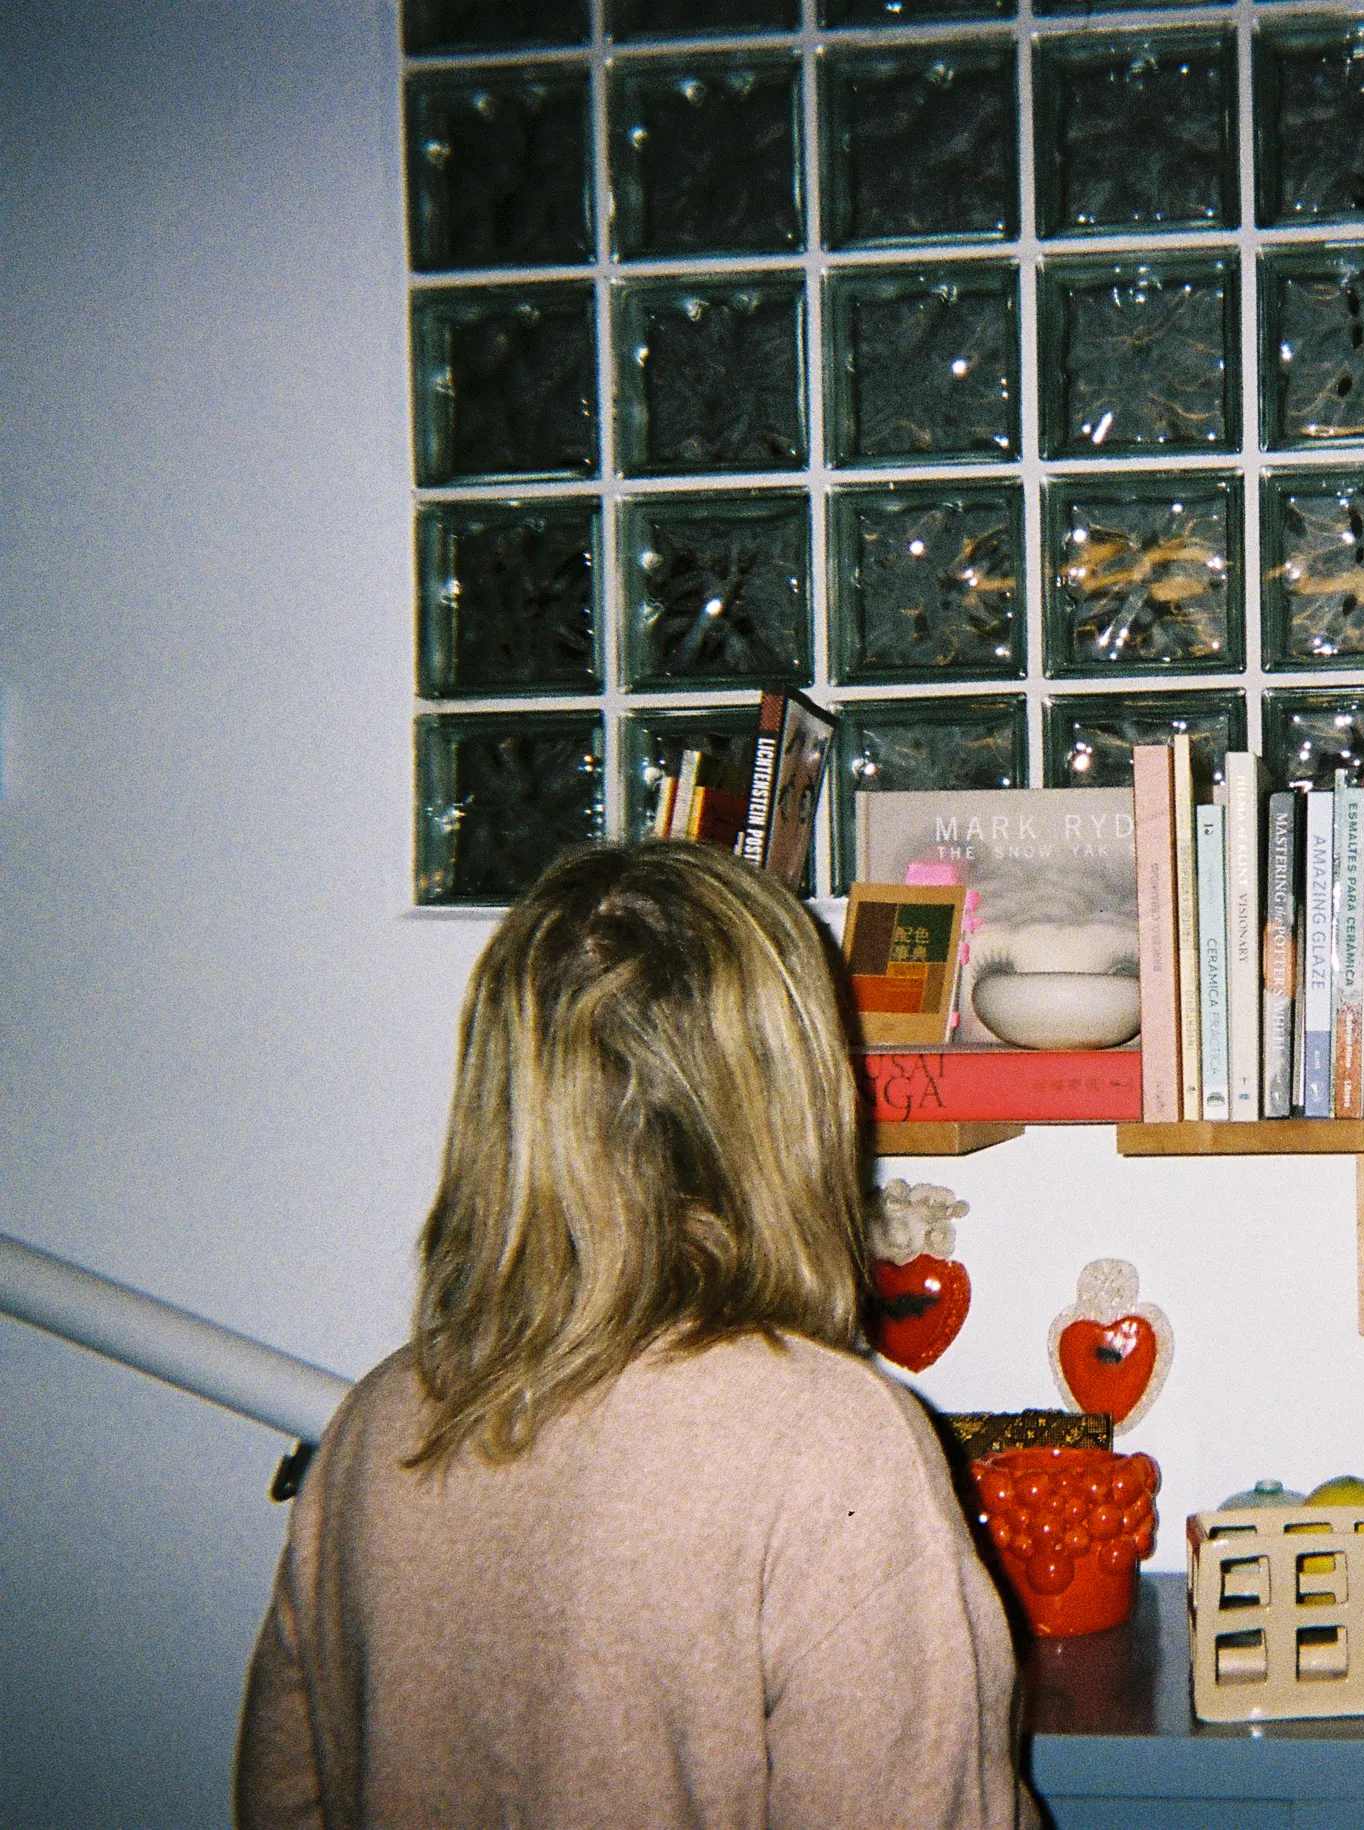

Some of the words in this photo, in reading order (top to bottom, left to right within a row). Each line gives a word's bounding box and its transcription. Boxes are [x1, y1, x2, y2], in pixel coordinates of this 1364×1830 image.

[747, 737, 776, 829] LICHTENSTEIN
[935, 816, 1037, 841] MARK
[1065, 813, 1135, 839] RYD
[937, 846, 976, 860] THE
[1275, 813, 1288, 907] MASTERING
[1348, 803, 1358, 872] ESMALTES
[1313, 835, 1327, 925] AMAZING
[1347, 877, 1357, 911] PARA
[1237, 893, 1249, 962] VISIONARY
[1311, 930, 1325, 989] GLAZE
[1345, 915, 1357, 986] CERÁMICA
[1206, 938, 1218, 1017] CERÁMICA
